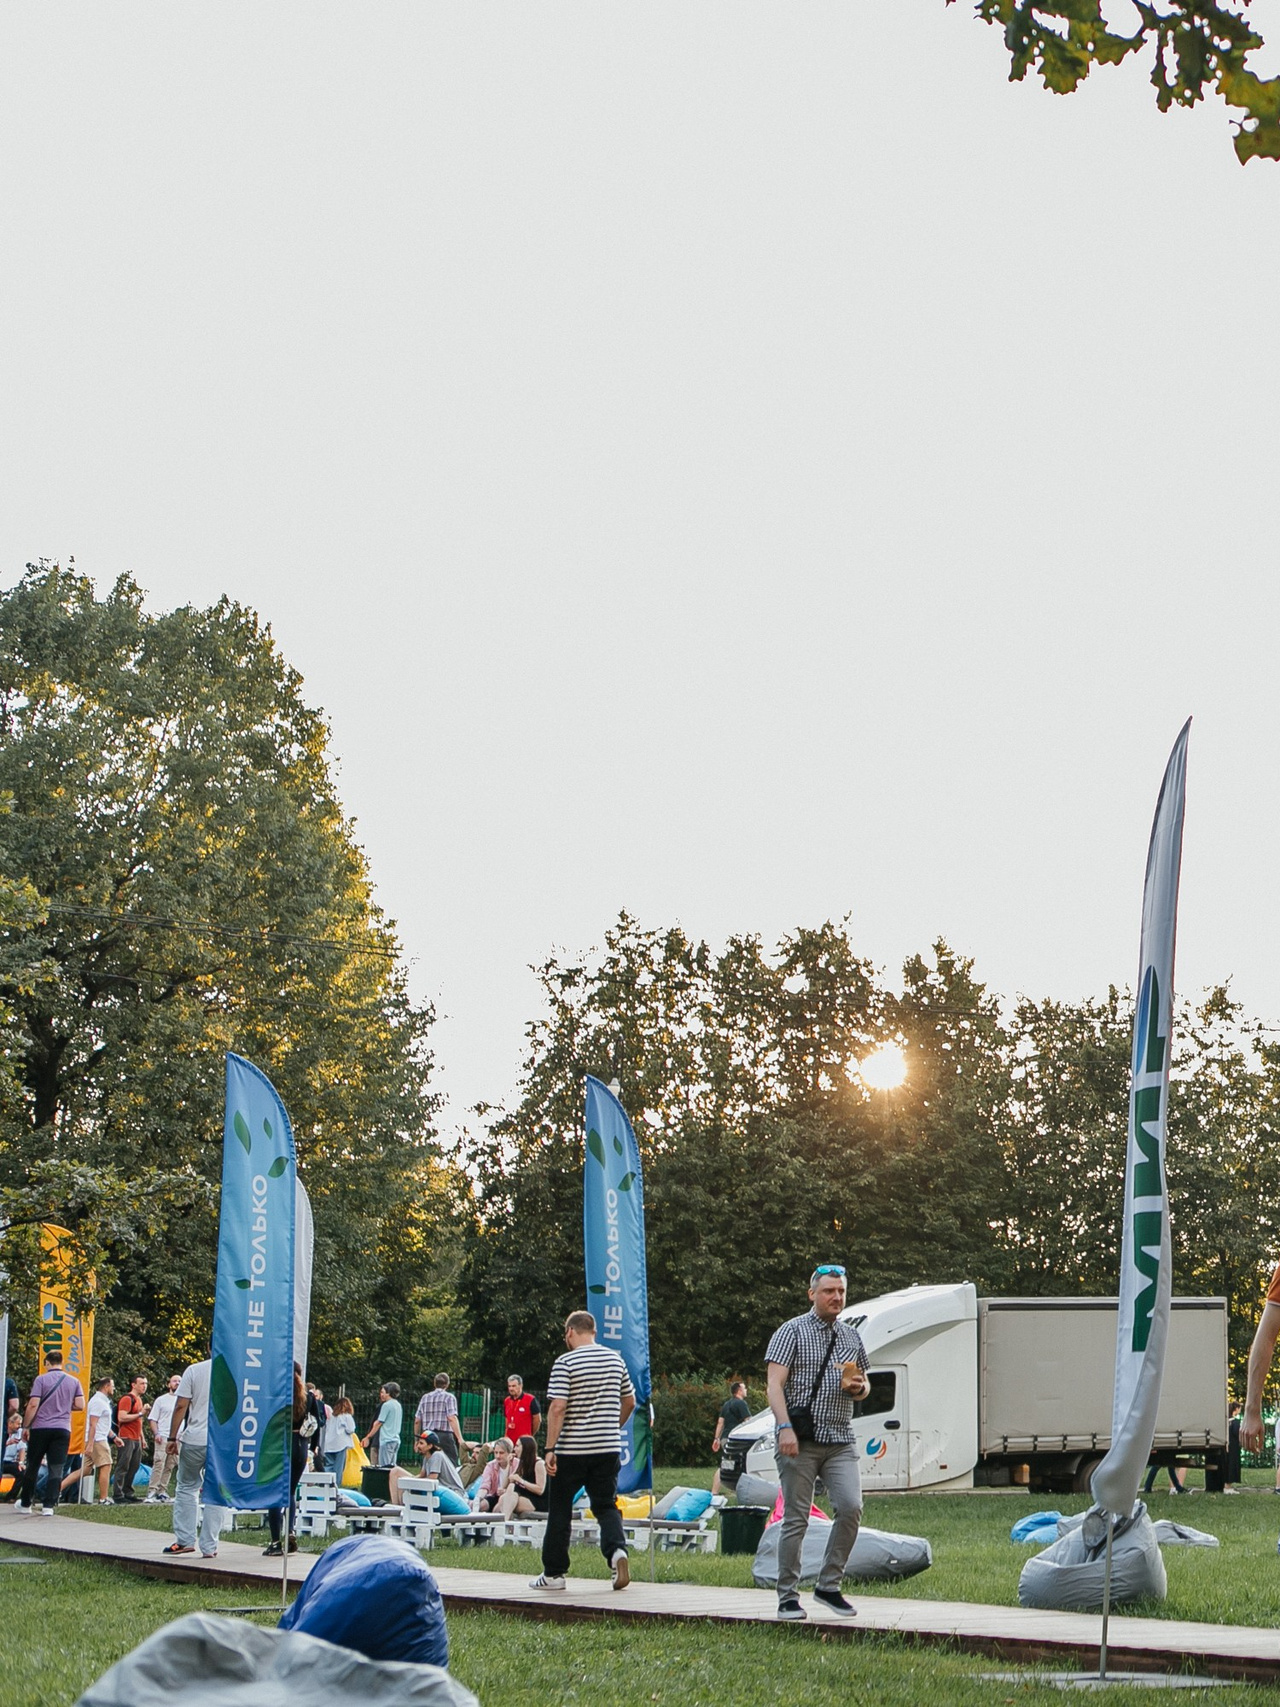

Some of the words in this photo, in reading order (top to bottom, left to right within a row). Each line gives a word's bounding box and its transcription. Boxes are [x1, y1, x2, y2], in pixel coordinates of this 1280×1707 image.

[250, 1174, 268, 1288] ТОЛЬКО
[604, 1188, 621, 1293] ТОЛЬКО
[247, 1300, 265, 1330] НЕ
[603, 1305, 623, 1340] НЕ
[245, 1348, 263, 1369] И
[236, 1379, 260, 1479] СПОРТ
